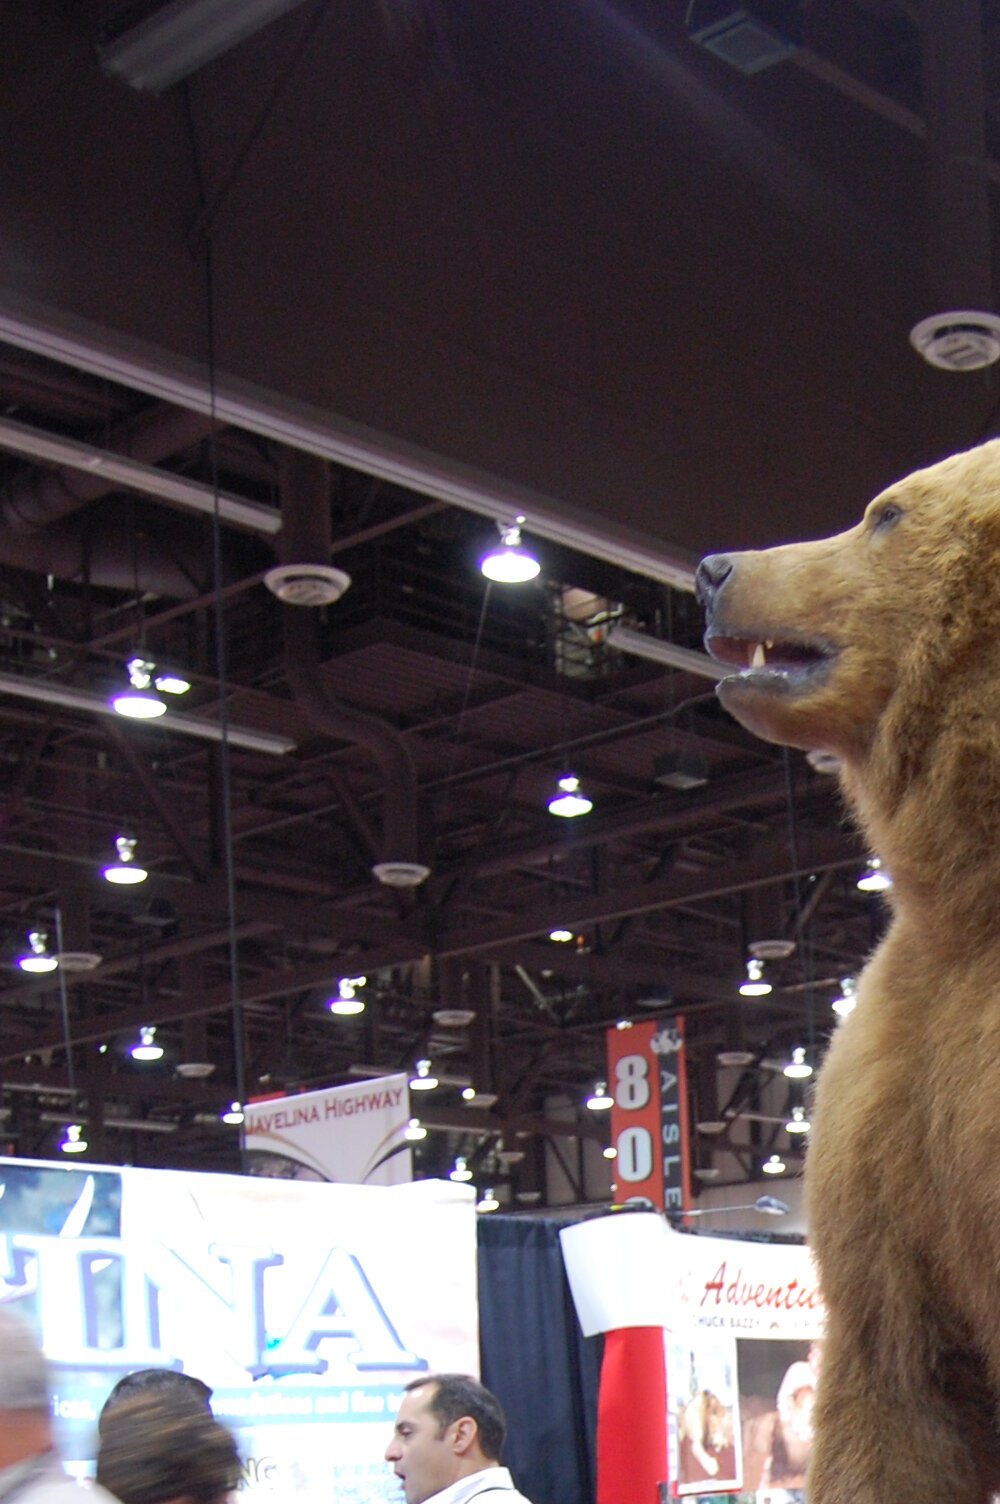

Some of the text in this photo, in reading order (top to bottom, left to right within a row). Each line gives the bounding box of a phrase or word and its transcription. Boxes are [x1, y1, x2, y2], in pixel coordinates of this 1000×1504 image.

[325, 1088, 404, 1121] HIGHWAY
[616, 1054, 652, 1207] 80
[661, 1070, 683, 1208] AISLE
[0, 1235, 428, 1378] INA
[700, 1260, 825, 1310] Adventu
